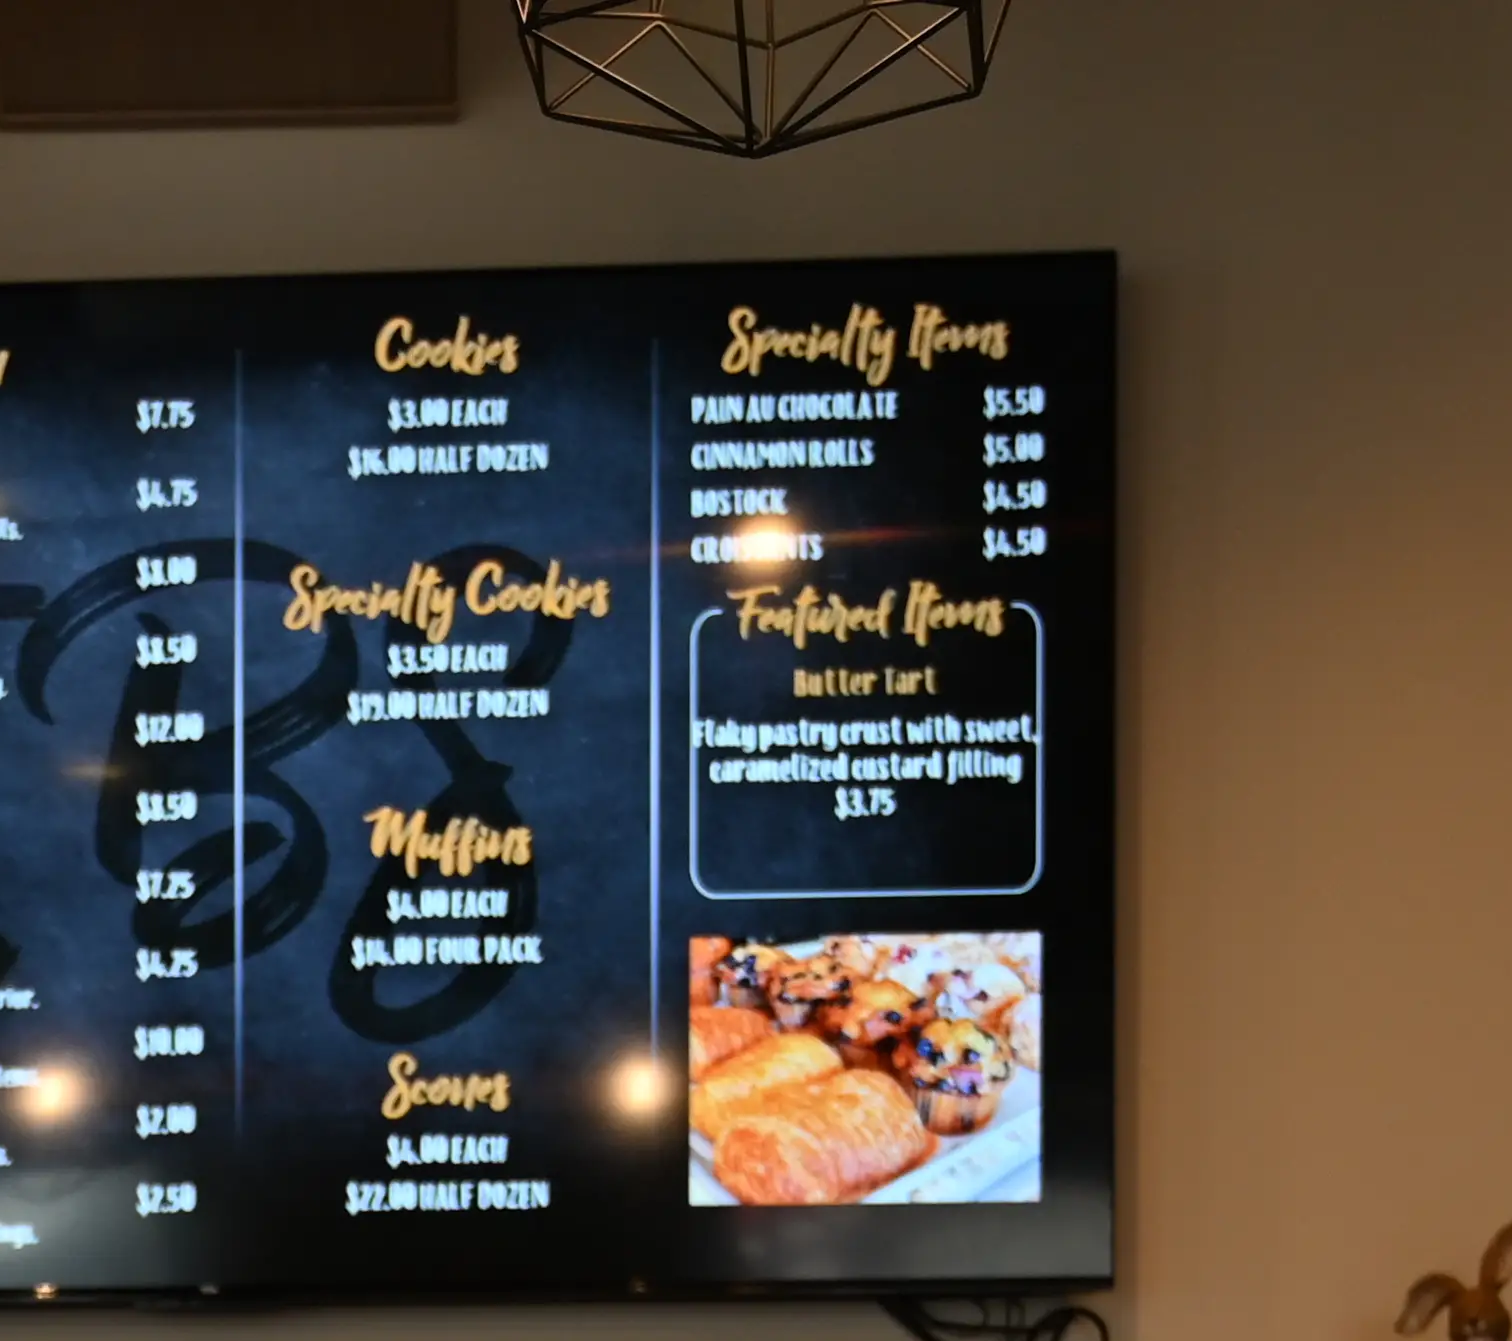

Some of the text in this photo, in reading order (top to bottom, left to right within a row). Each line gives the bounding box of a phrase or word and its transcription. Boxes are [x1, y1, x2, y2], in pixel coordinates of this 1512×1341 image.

[375, 315, 520, 376] Cookies
[720, 303, 1010, 387] Specialty Items
[451, 398, 509, 427] EACH
[691, 391, 897, 424] PAIN AU CHOCOLATE
[983, 385, 1045, 419] $5.50
[418, 445, 473, 474] HALF
[476, 443, 549, 473] DOZEN
[690, 438, 875, 470] CINNAMON ROLLS
[983, 432, 1045, 466] $5.00
[690, 487, 788, 517] BOSTOCK
[982, 479, 1047, 513] $4.50
[982, 526, 1047, 560] $4.50
[283, 557, 610, 644] Specialty Cookies
[727, 580, 1004, 650] Featured Items
[386, 643, 509, 678] $3.50 EACH
[793, 667, 935, 697] Butter Tart
[418, 690, 474, 720] HALF
[476, 688, 550, 719] DOZEN
[693, 714, 756, 752] Flaky
[759, 714, 837, 752] pastry
[840, 714, 902, 752] crust
[906, 714, 962, 752] with
[709, 746, 1023, 785] caramelized custard filling
[834, 786, 897, 821] $3.75
[363, 805, 533, 878] Muffins
[450, 889, 509, 919] EACH
[425, 936, 482, 965] FOUR
[483, 935, 543, 964] PACK
[381, 1053, 511, 1120] Scones
[450, 1135, 509, 1165] EACH
[418, 1181, 475, 1211] HALF
[477, 1180, 550, 1210] DOZEN
